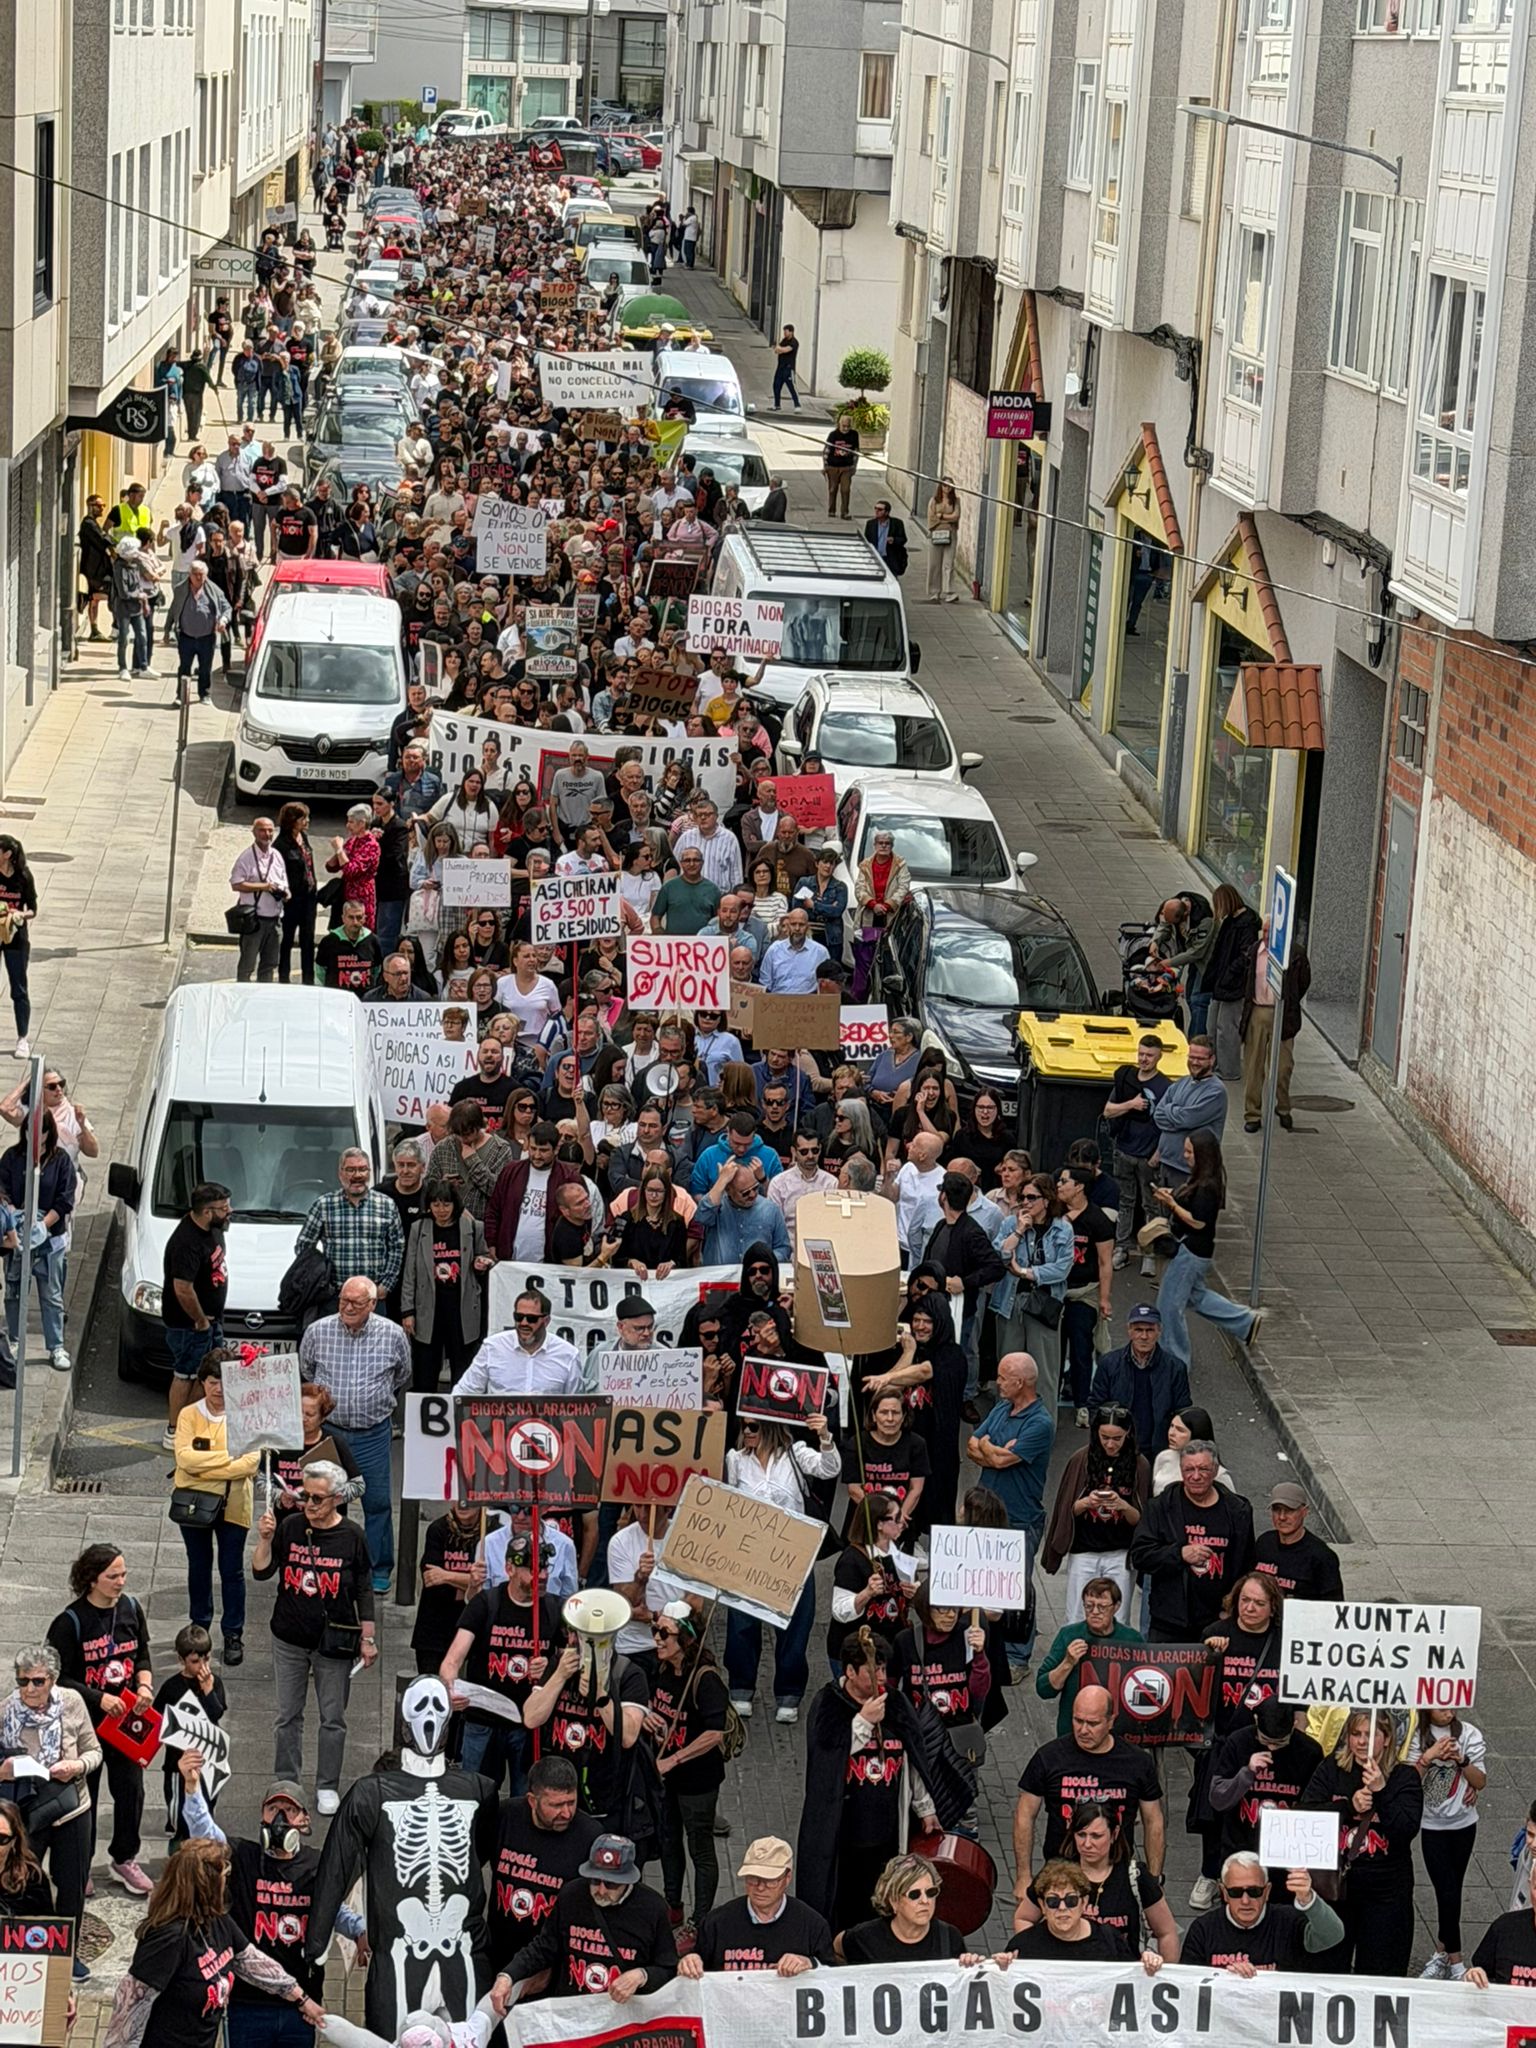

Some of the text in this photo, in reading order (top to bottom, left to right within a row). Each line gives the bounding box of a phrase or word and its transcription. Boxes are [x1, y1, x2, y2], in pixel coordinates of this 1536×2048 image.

[425, 88, 435, 99] P
[542, 283, 575, 294] STOP
[548, 361, 644, 371] ALGO CHEIRA MAL
[548, 376, 622, 386] NO CONCELLO
[561, 390, 634, 399] DA LARACHA
[992, 396, 1032, 408] MODA
[481, 501, 527, 525] SOMOS
[532, 512, 542, 528] O
[484, 532, 493, 542] A
[496, 544, 528, 554] NON
[484, 556, 542, 569] SE VENDE
[690, 599, 784, 622] BIOGAS NON
[702, 617, 751, 636] FORA
[636, 671, 698, 696] STOP
[629, 694, 691, 717] BIOGAS
[540, 897, 610, 922] 63.500 T
[1272, 880, 1286, 948] P
[537, 924, 551, 942] DE
[630, 940, 726, 973] SURRO
[655, 974, 719, 1008] NON
[384, 1066, 415, 1090] POLA
[602, 1354, 610, 1371] O
[603, 1374, 688, 1390] JODER estes
[743, 1364, 825, 1410] NON
[515, 1403, 533, 1416] NA
[536, 1404, 597, 1416] LARACHA?
[462, 1418, 606, 1482] NON
[696, 1485, 793, 1542] O RURAL
[686, 1512, 726, 1540] NON
[769, 1545, 796, 1570] UN
[1334, 1605, 1446, 1634] XUNTA!
[492, 1624, 525, 1638] BIOGÁS
[1091, 1645, 1208, 1665] BIOGÁS NA LARACHA?
[1224, 1656, 1256, 1666] BIOGÁS
[1290, 1638, 1465, 1669] BIOGÁS NA
[1080, 1661, 1216, 1722] NON
[1281, 1674, 1474, 1706] LARACHA NON
[1062, 1775, 1099, 1787] BIOGÁS
[500, 1848, 538, 1869] BIOGÁS
[497, 1862, 564, 1889] NA LARACHA?
[497, 1880, 558, 1922] NON
[4, 1924, 69, 1951] NON
[570, 1925, 606, 1943] BIOGÁ
[724, 1946, 764, 1961] BIOGÁS
[796, 1971, 1410, 2048] BIOGÁS ASÍ NON
